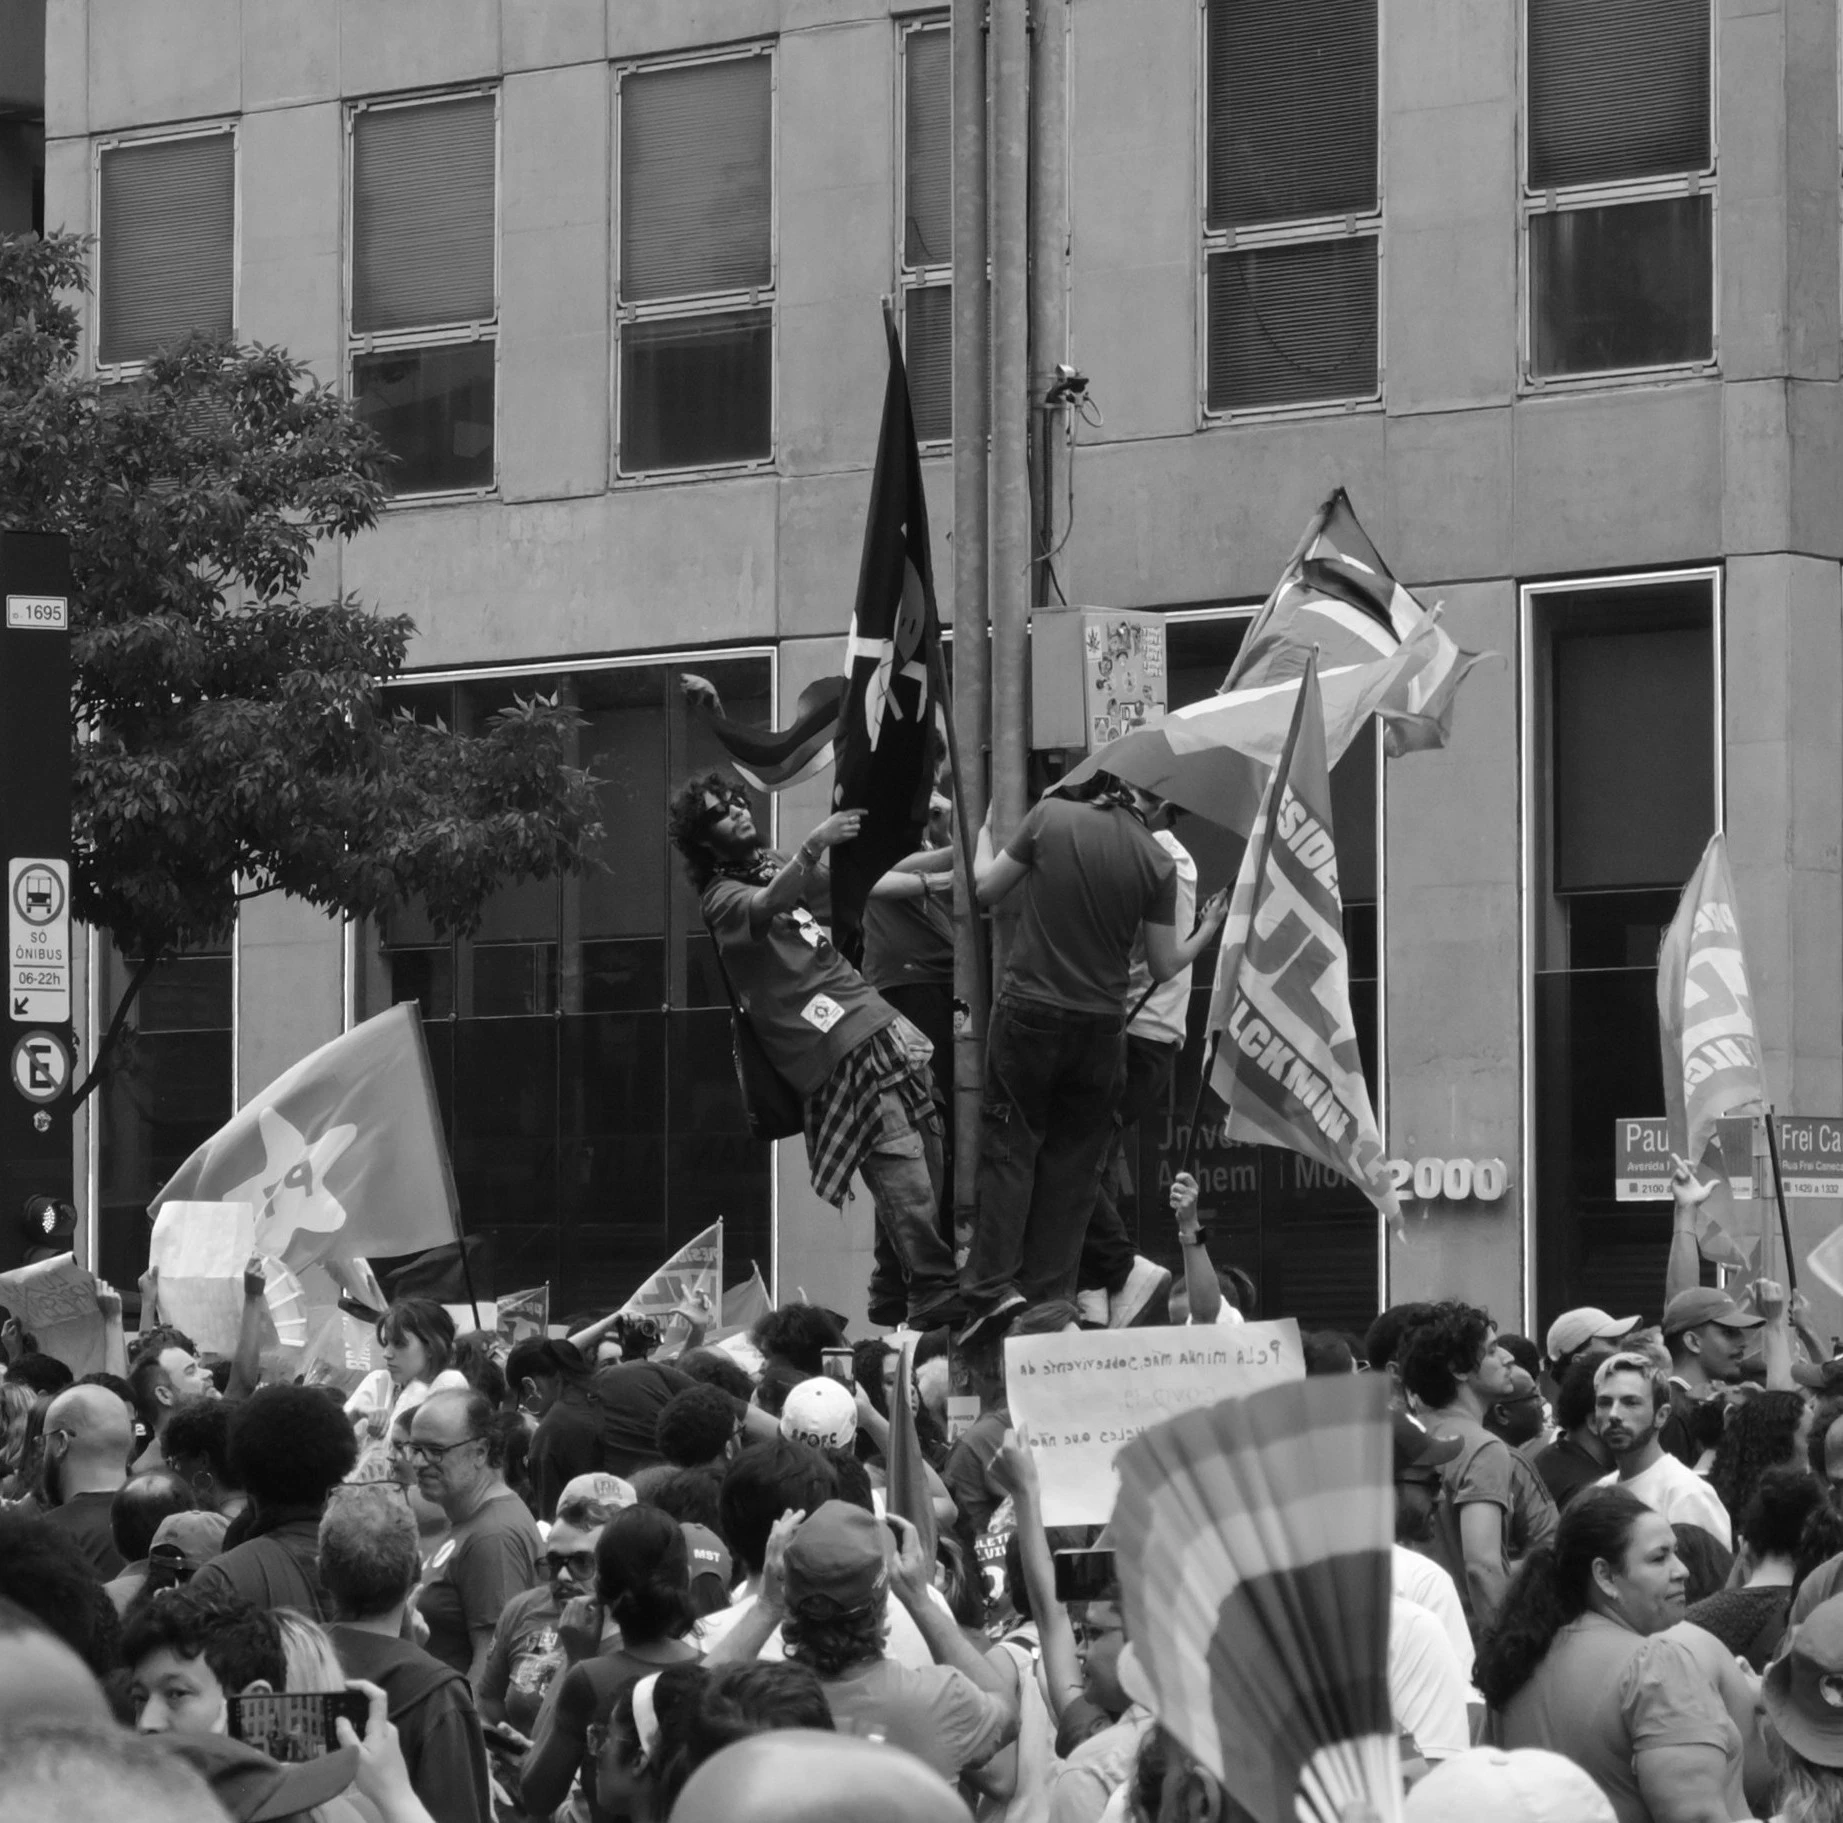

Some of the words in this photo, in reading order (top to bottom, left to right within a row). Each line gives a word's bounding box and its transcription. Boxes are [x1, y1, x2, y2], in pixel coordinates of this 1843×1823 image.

[26, 604, 62, 621] 1695
[30, 928, 48, 944] SÓ
[16, 945, 63, 960] ÔNIBUS
[19, 972, 61, 985] 06-22h
[1228, 988, 1352, 1144] LCKMIN
[1626, 1123, 1670, 1152] Pau
[1782, 1123, 1812, 1152] Frei
[1819, 1124, 1843, 1152] Ca
[1386, 1157, 1507, 1201] 2000
[693, 1548, 721, 1563] MST
